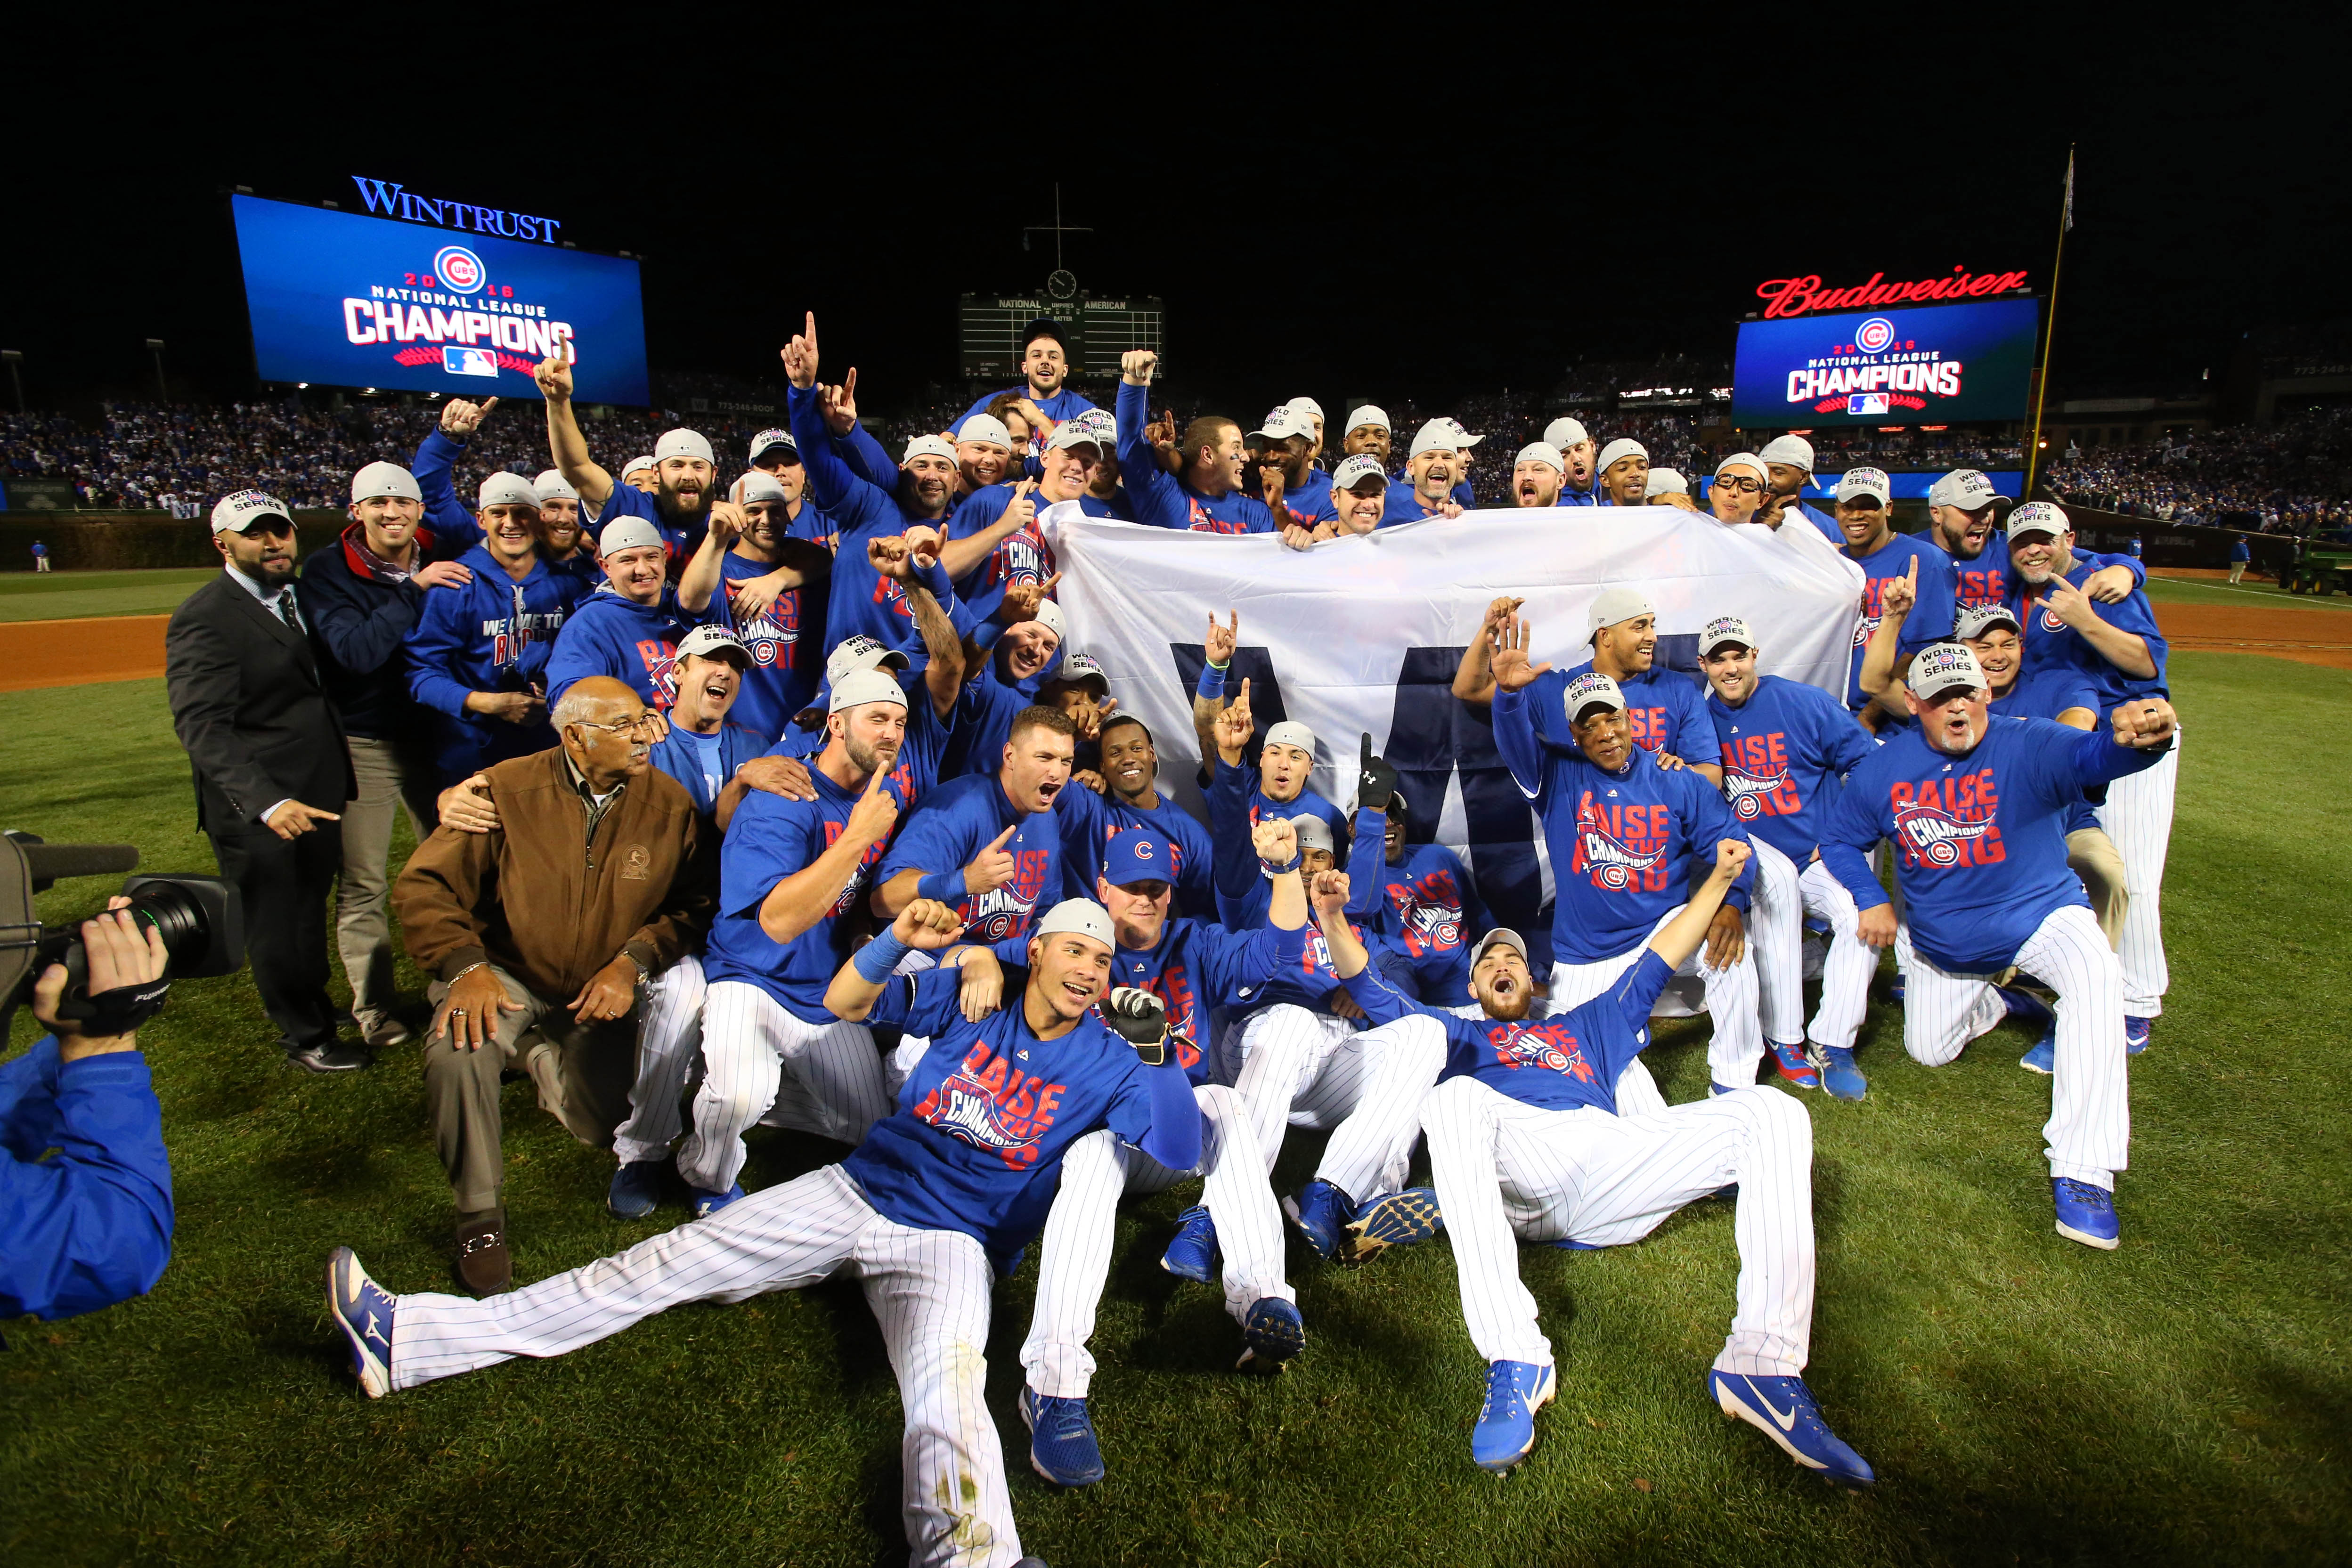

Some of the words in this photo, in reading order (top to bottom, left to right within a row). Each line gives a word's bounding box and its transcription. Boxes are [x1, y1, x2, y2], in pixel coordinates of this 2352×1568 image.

[351, 175, 560, 243] WINTRUST
[1756, 265, 2027, 318] Budweiser
[371, 286, 472, 309] NATIONAL
[478, 299, 547, 317] LEAGUE
[999, 300, 1041, 308] NATIONAL
[1085, 301, 1126, 309] AMERICAN
[343, 298, 576, 365] CHAMPIONS
[1808, 355, 1878, 368] NATIONAL
[1883, 351, 1939, 364] LEAGUE
[1787, 361, 1962, 402] CHAMPIONS
[1273, 407, 1289, 416] RLD
[1851, 468, 1885, 479] WORLD
[1848, 479, 1883, 490] SERIES
[2012, 504, 2051, 517] WORLD
[2013, 514, 2051, 528] SERIES
[483, 619, 506, 636] WE
[544, 614, 563, 629] TO
[1706, 617, 1742, 629] WORLD
[1973, 611, 2010, 622] SERIES
[738, 618, 798, 642] CHAMPIONS
[1708, 628, 1744, 640] SERIES
[1922, 648, 1968, 663] WORLD
[1924, 662, 1972, 677] SERIES
[1569, 674, 1606, 690] WORLD
[1571, 684, 1610, 702] SERIES
[1720, 732, 1788, 767] AISE
[1890, 767, 1999, 813] RAISE
[1906, 817, 1986, 847] CHAMPIONS
[1135, 841, 1153, 860] C
[1586, 832, 1654, 867] CHAMPIONS
[1933, 843, 1953, 860] CUBS
[1606, 868, 1623, 883] CUBS
[978, 888, 1033, 918] CHAMPIONS
[991, 917, 1006, 936] CUBS
[954, 1039, 1067, 1126] RAISE
[944, 1089, 1021, 1146] CHAMPIONS
